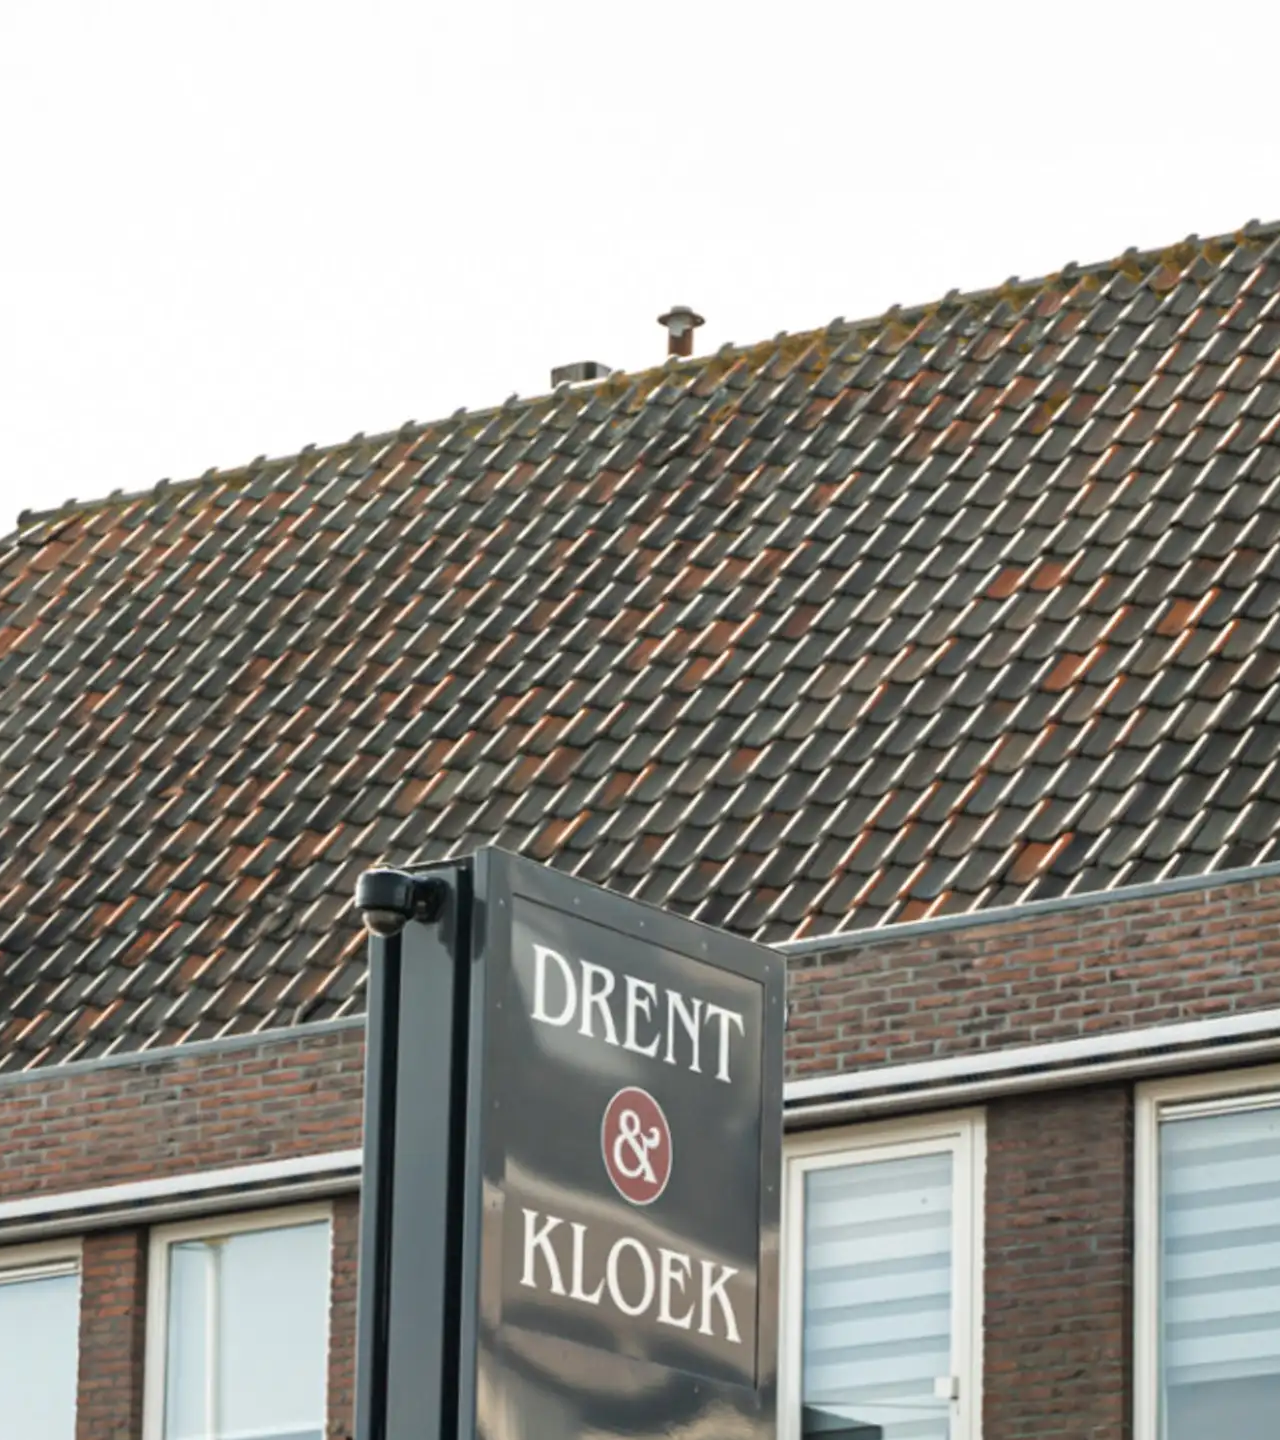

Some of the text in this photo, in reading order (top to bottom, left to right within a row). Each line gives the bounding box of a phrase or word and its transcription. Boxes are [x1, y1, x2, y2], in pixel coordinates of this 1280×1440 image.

[531, 943, 744, 1082] DRENT
[613, 1109, 661, 1183] &
[520, 1208, 741, 1343] KLOEK
